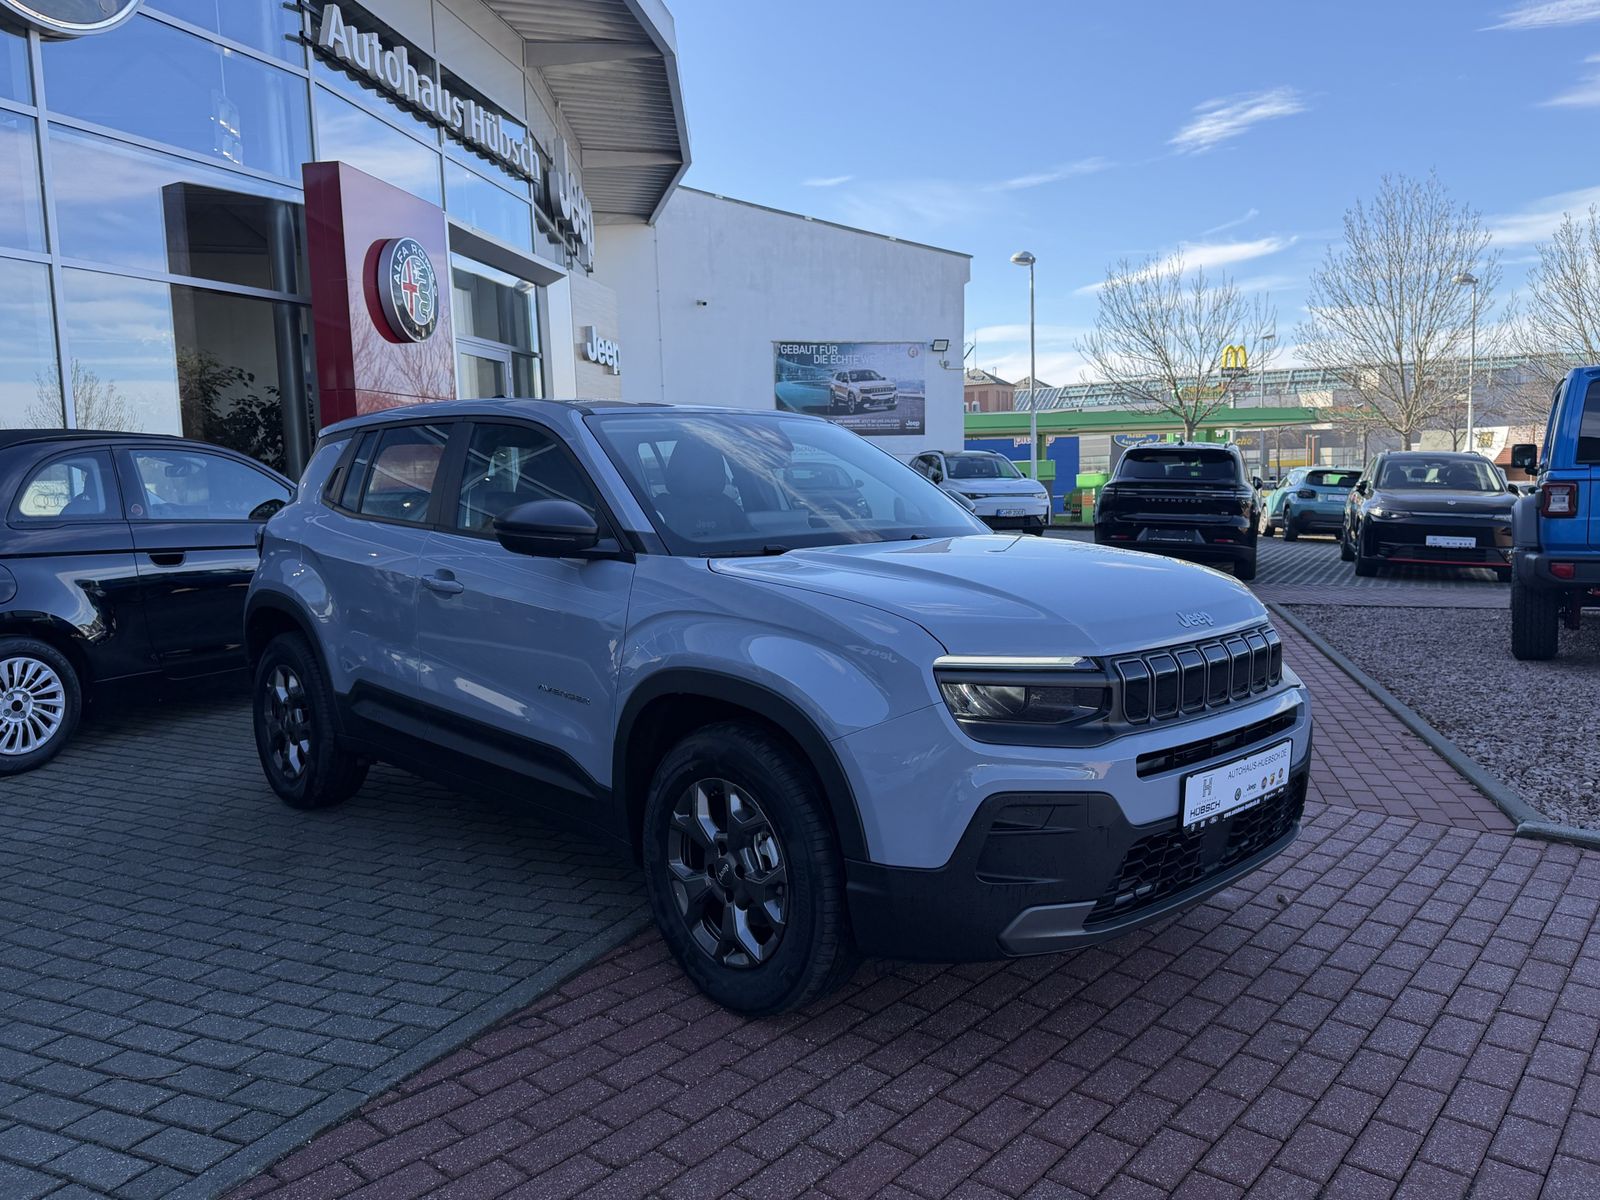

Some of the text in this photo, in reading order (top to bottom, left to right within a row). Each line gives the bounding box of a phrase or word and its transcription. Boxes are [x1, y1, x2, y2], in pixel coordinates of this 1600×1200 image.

[320, 3, 541, 186] Autohaus Hübsch
[551, 137, 595, 271] Jeep
[394, 243, 438, 297] ALFA ROMEO
[584, 325, 621, 376] Jeep
[780, 343, 838, 355] GEBAUT FÜR
[813, 354, 828, 364] DIE
[830, 354, 859, 364] ECHTE
[905, 419, 920, 428] Jeep
[1175, 611, 1214, 629] Jeep
[538, 683, 591, 706] AVENGER
